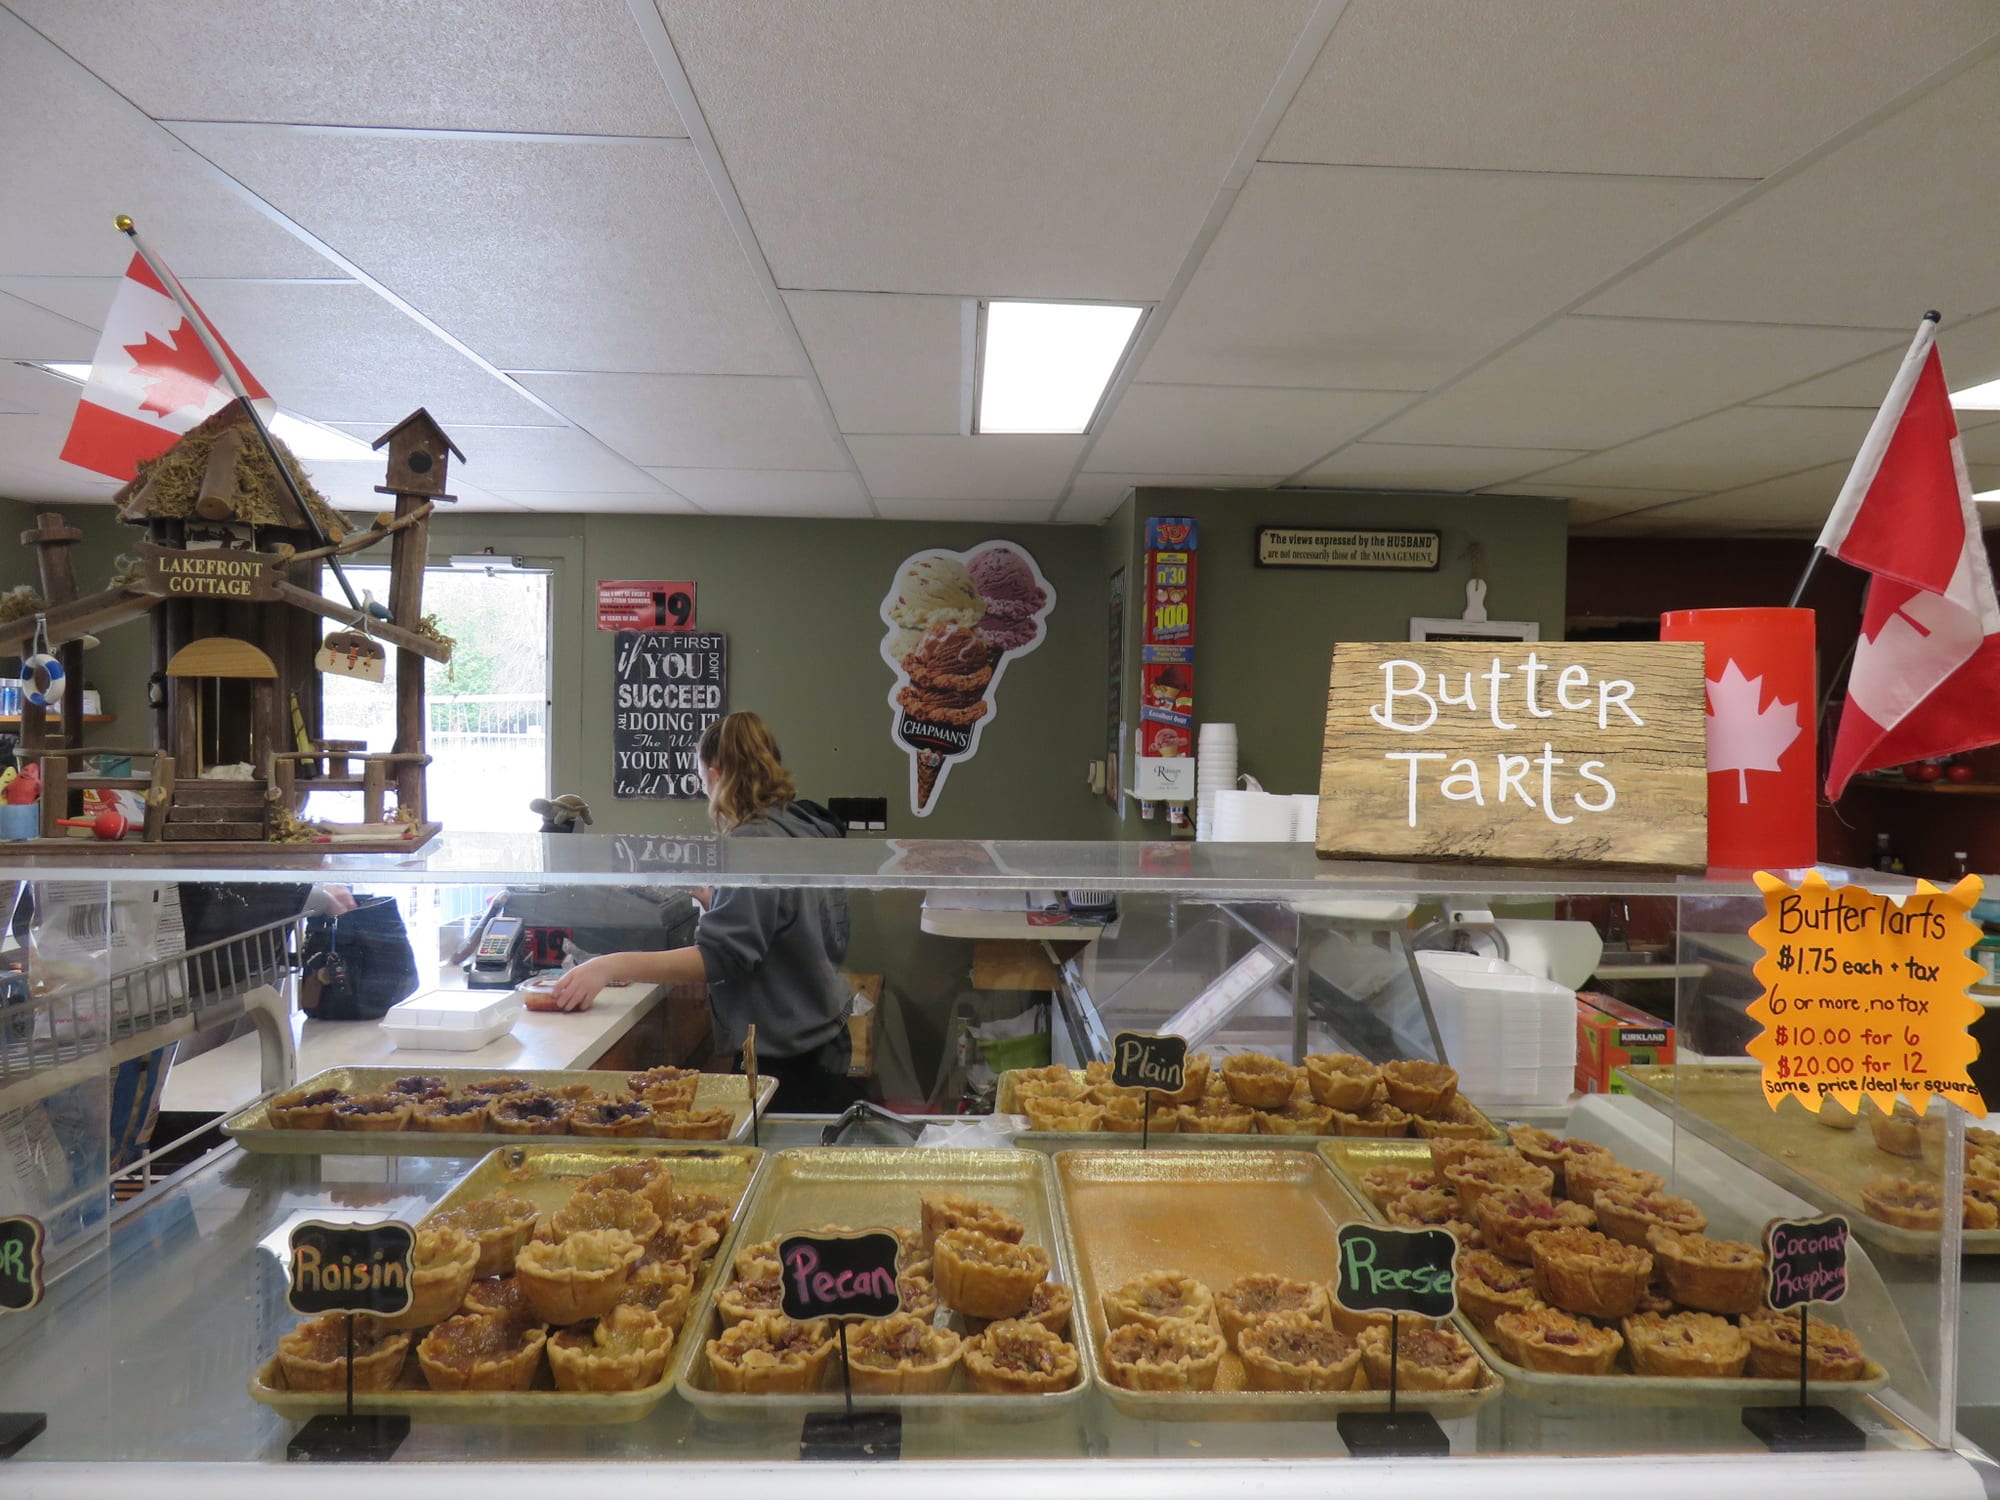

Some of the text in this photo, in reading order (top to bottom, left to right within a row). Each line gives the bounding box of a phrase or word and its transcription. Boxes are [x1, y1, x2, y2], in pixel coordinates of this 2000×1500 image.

[1270, 533, 1432, 549] The views expressed by the HUSBAND
[160, 557, 263, 577] LAKEFRONT
[169, 577, 251, 596] COTTAGE
[653, 592, 692, 626] 19
[1155, 603, 1188, 630] 100
[647, 637, 721, 649] AT FIRST
[618, 634, 646, 680] if
[642, 652, 705, 679] YOU
[618, 684, 721, 708] SUCCEED
[618, 712, 627, 730] TRY
[629, 712, 720, 731] DOING IT
[903, 720, 969, 747] CHAPMAN'S
[632, 734, 698, 748] The Wa
[618, 751, 669, 770] YOUR
[618, 773, 708, 796] told YO
[1779, 893, 1875, 934] Butter
[1776, 945, 1837, 975] $1.75
[1842, 959, 1883, 976] each
[1904, 956, 1940, 982] tax
[1769, 983, 1788, 1015] 6
[1793, 997, 1813, 1010] or
[1896, 994, 1929, 1015] tax
[1621, 1033, 1666, 1042] KIRKLAND
[1775, 1025, 1920, 1046] $10.00 for 6
[1119, 1040, 1181, 1086] Plain
[1777, 1051, 1928, 1079] $20.00 for 12
[785, 1244, 897, 1304] Pecan
[1342, 1236, 1454, 1295] Reese
